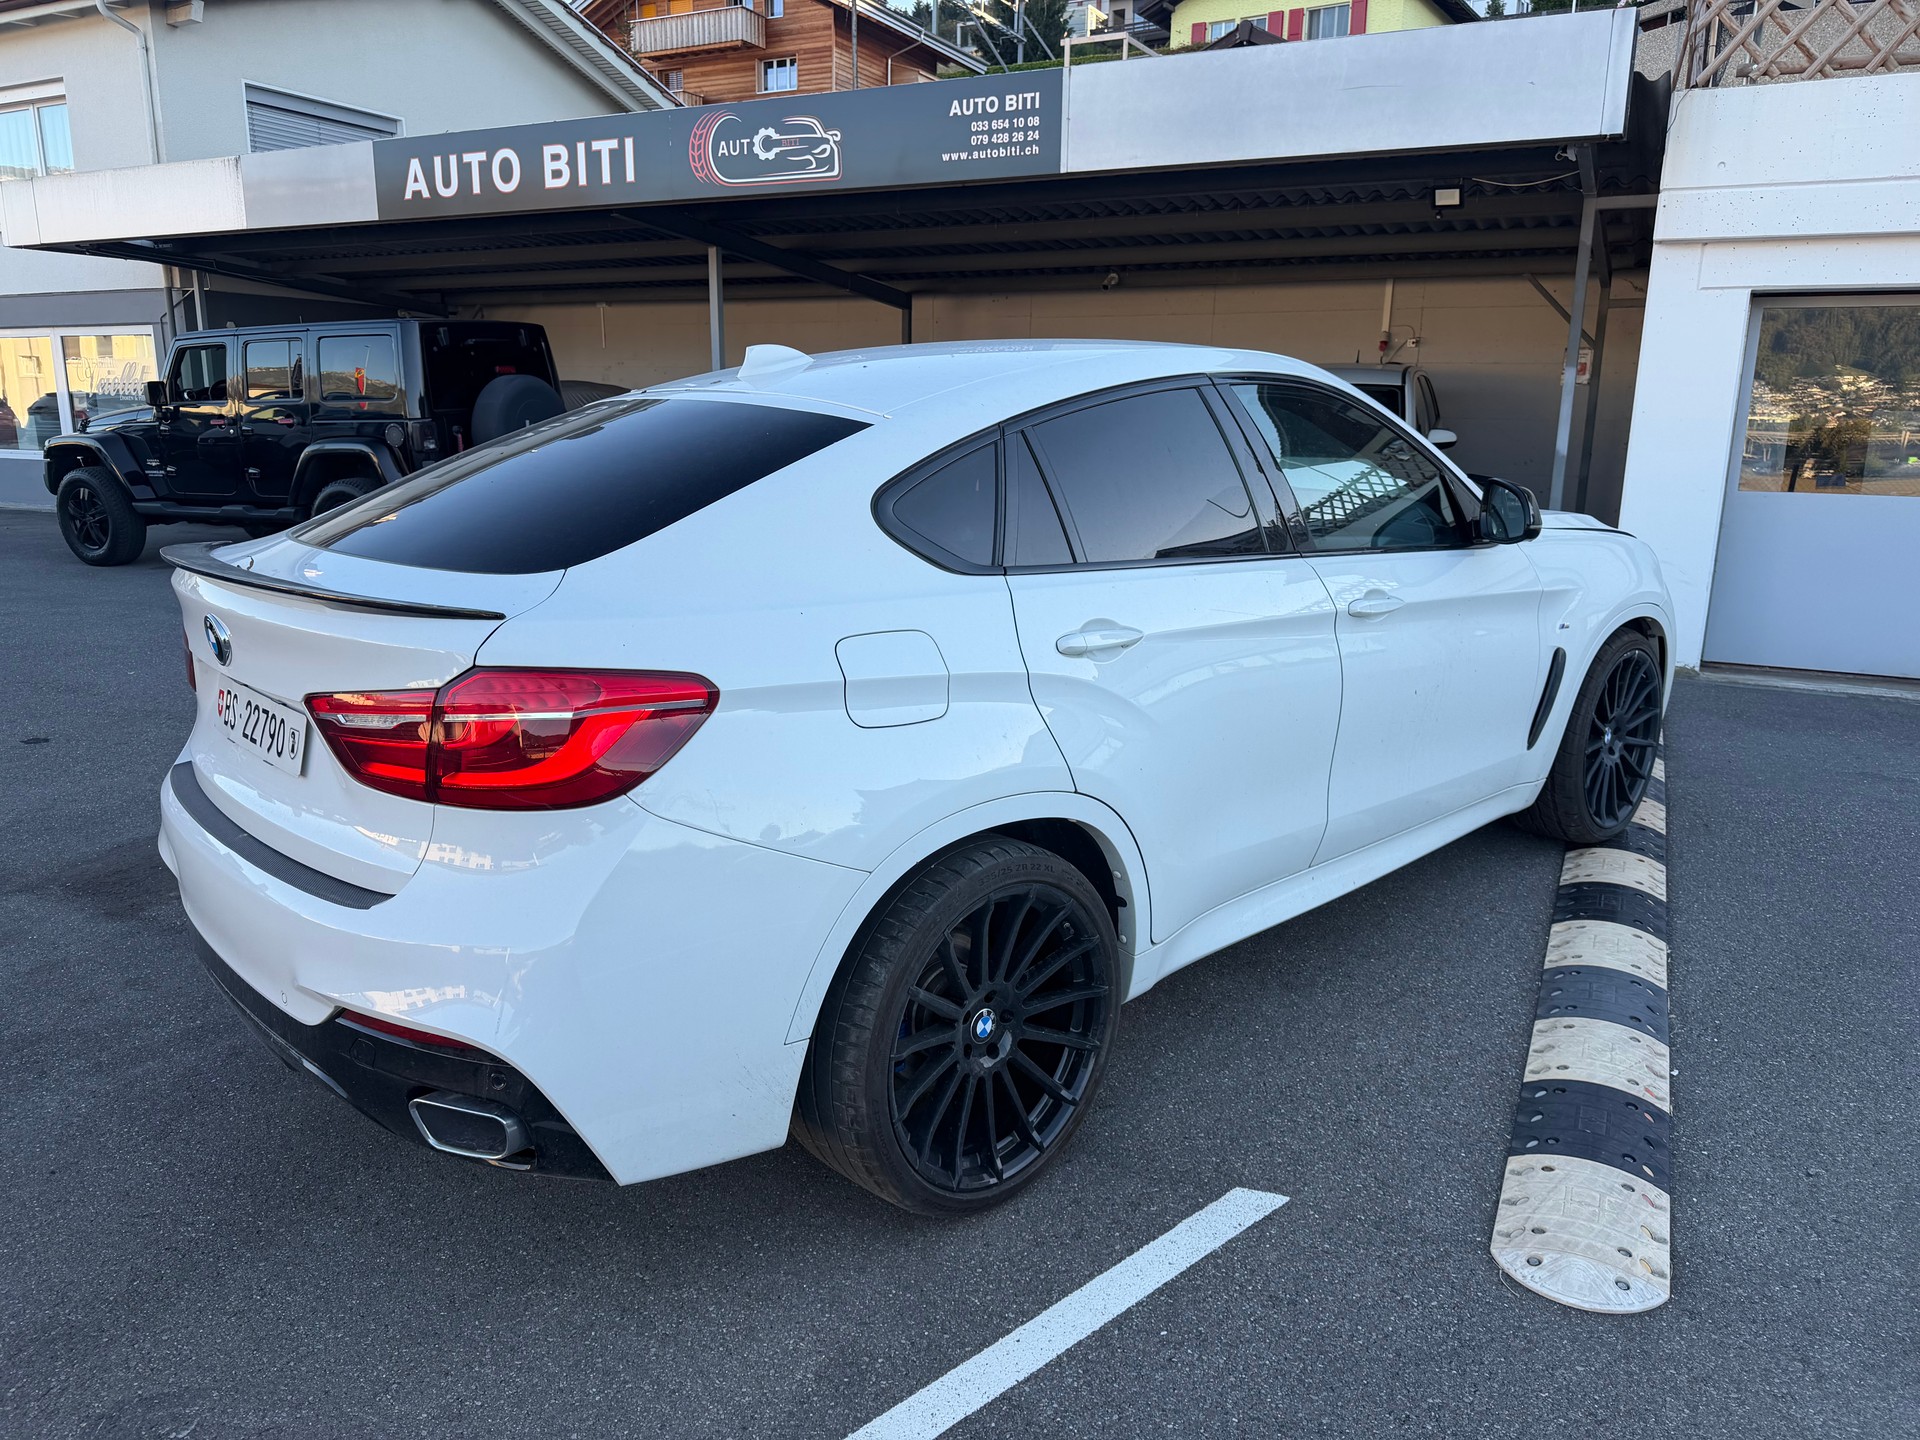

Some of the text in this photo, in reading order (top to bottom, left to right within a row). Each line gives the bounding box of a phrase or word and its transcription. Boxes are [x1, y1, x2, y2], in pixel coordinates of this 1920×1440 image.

[949, 92, 1040, 117] AUTO BITI
[971, 116, 1040, 132] 033 654 10 08
[781, 138, 800, 147] BITI
[971, 130, 1040, 145] 079 428 26 24
[942, 145, 1040, 162] www.autobiti.ch
[404, 136, 636, 200] AUTO BITI
[242, 700, 286, 758] 22790
